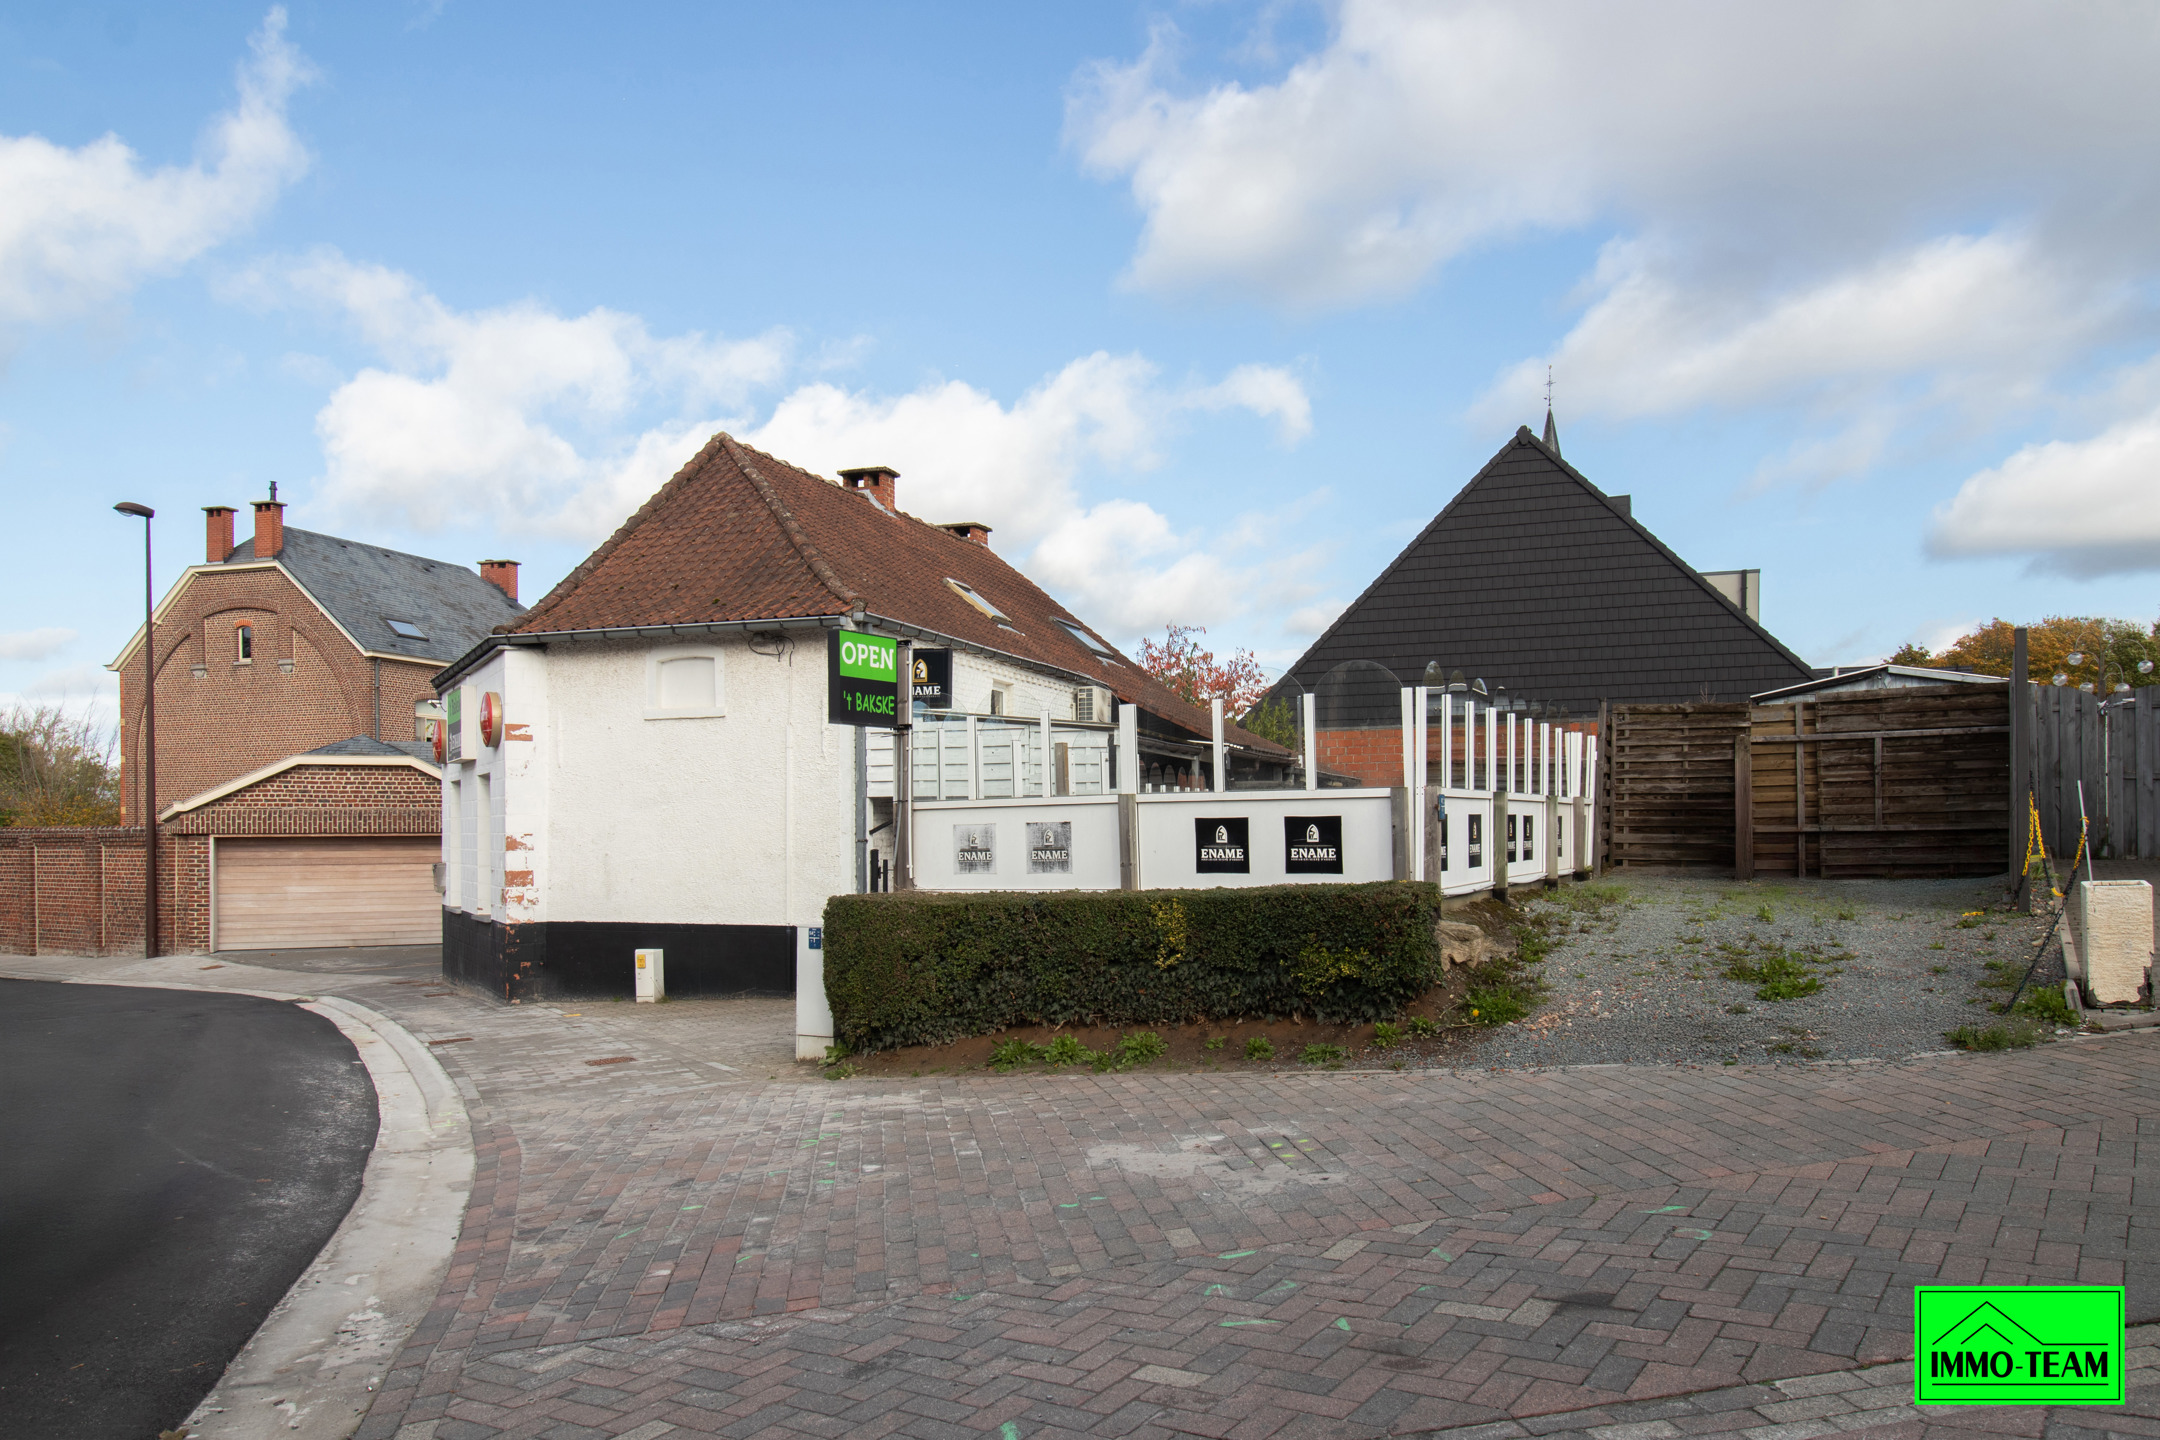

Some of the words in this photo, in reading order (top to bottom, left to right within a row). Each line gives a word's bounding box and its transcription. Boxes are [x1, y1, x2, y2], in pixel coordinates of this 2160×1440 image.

[842, 642, 894, 670] OPEN
[913, 686, 941, 695] AME
[843, 691, 852, 711] 't
[855, 693, 895, 715] BAKSKE
[959, 852, 992, 860] ENAME
[1032, 851, 1068, 859] ENAME
[1201, 848, 1244, 858] ENAME
[1291, 848, 1337, 858] ENAME
